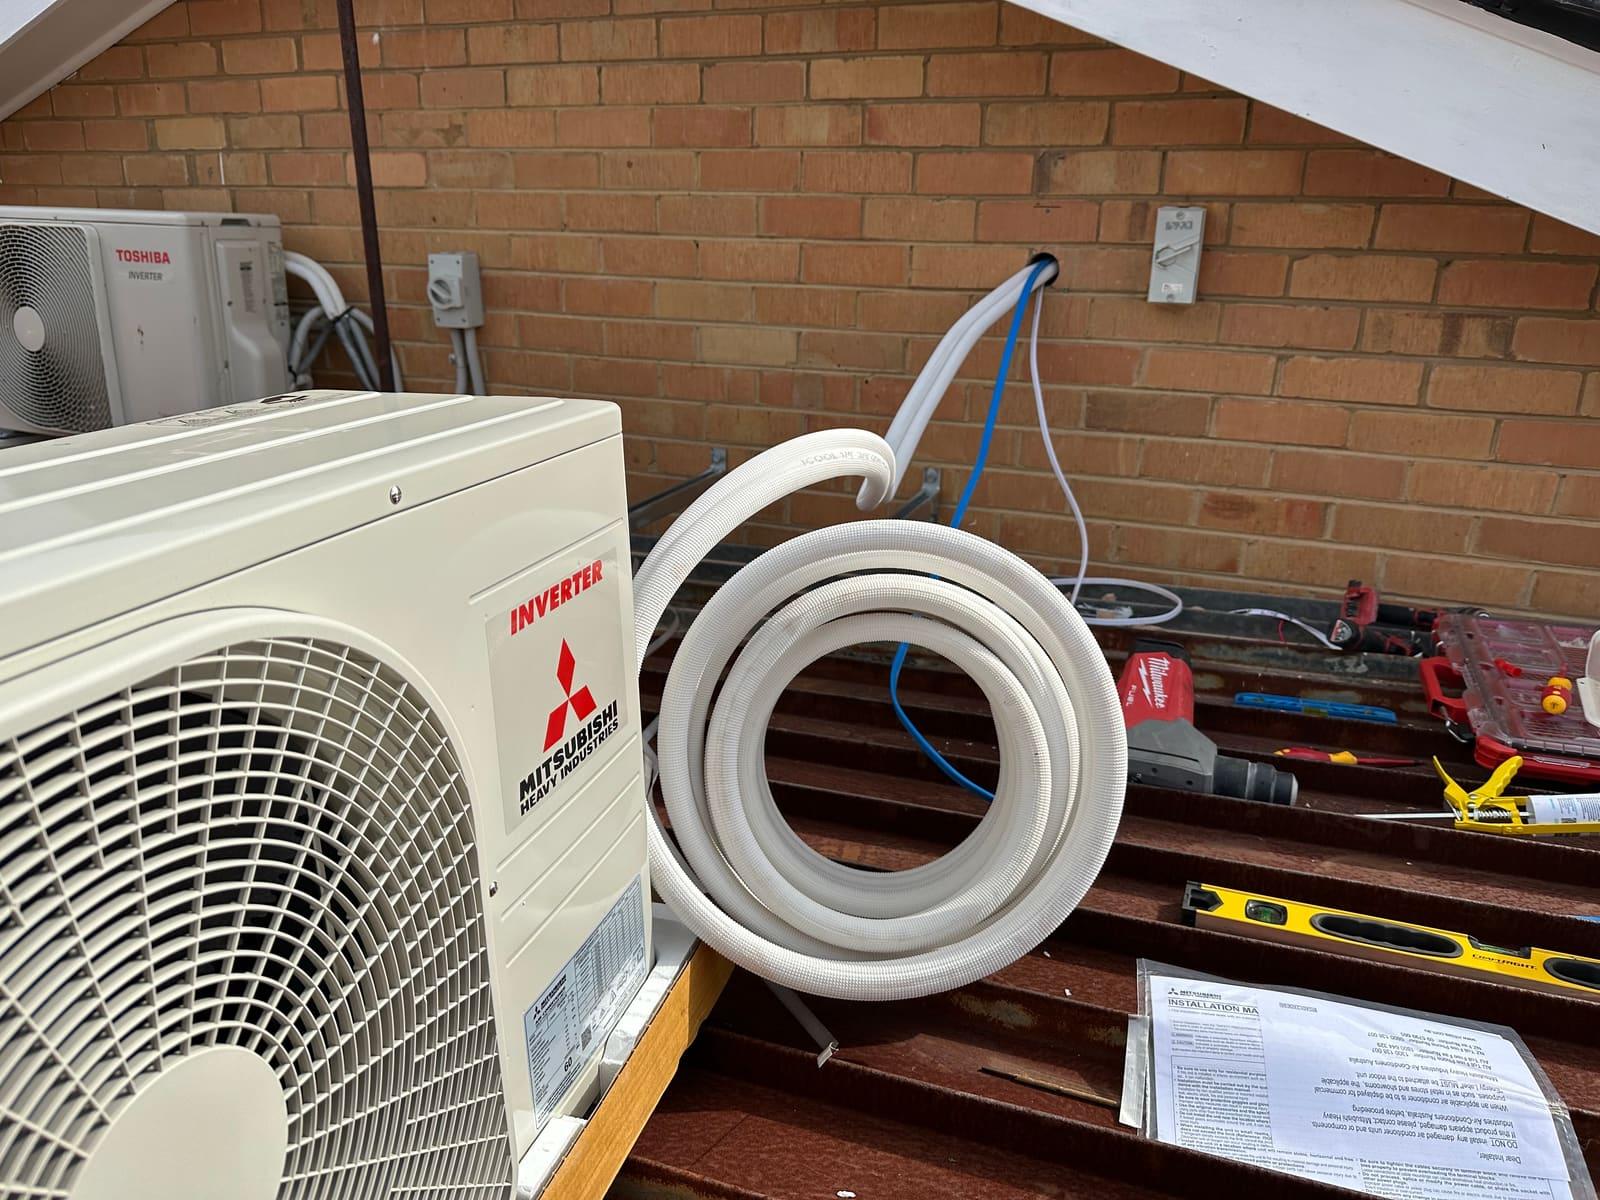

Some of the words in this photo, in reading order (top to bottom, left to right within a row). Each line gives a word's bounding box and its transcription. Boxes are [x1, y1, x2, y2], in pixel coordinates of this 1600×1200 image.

[116, 249, 171, 264] TOSHIBA
[128, 271, 163, 281] INVERTER
[510, 559, 603, 636] INVERTER
[1148, 657, 1170, 709] Milwaukee
[519, 699, 618, 802] MITSUBISHI
[520, 778, 557, 817] HEAVY
[560, 719, 619, 780] INDUSTRIES
[1168, 999, 1239, 1012] INSTALLATION
[1321, 1078, 1349, 1088] applicable
[1405, 1077, 1429, 1085] attached
[1440, 1081, 1458, 1089] MUST
[1314, 1087, 1346, 1095] commercial
[1357, 1090, 1384, 1099] displayed
[1408, 1096, 1439, 1104] conditioner
[1450, 1099, 1479, 1108] applicable
[1490, 1104, 1508, 1112] When
[1323, 1112, 1341, 1120] Heavy
[1386, 1109, 1404, 1117] before
[1342, 1115, 1371, 1124] Mitsubishi
[1483, 1119, 1513, 1128] Industries
[1397, 1120, 1416, 1128] please
[1384, 1129, 1416, 1137] conditioner
[1449, 1125, 1473, 1133] appears
[1475, 1128, 1497, 1136] product
[1427, 1132, 1454, 1142] damaged
[1457, 1135, 1468, 1143] any
[1507, 1140, 1518, 1148] DO
[1506, 1156, 1521, 1164] Dear
